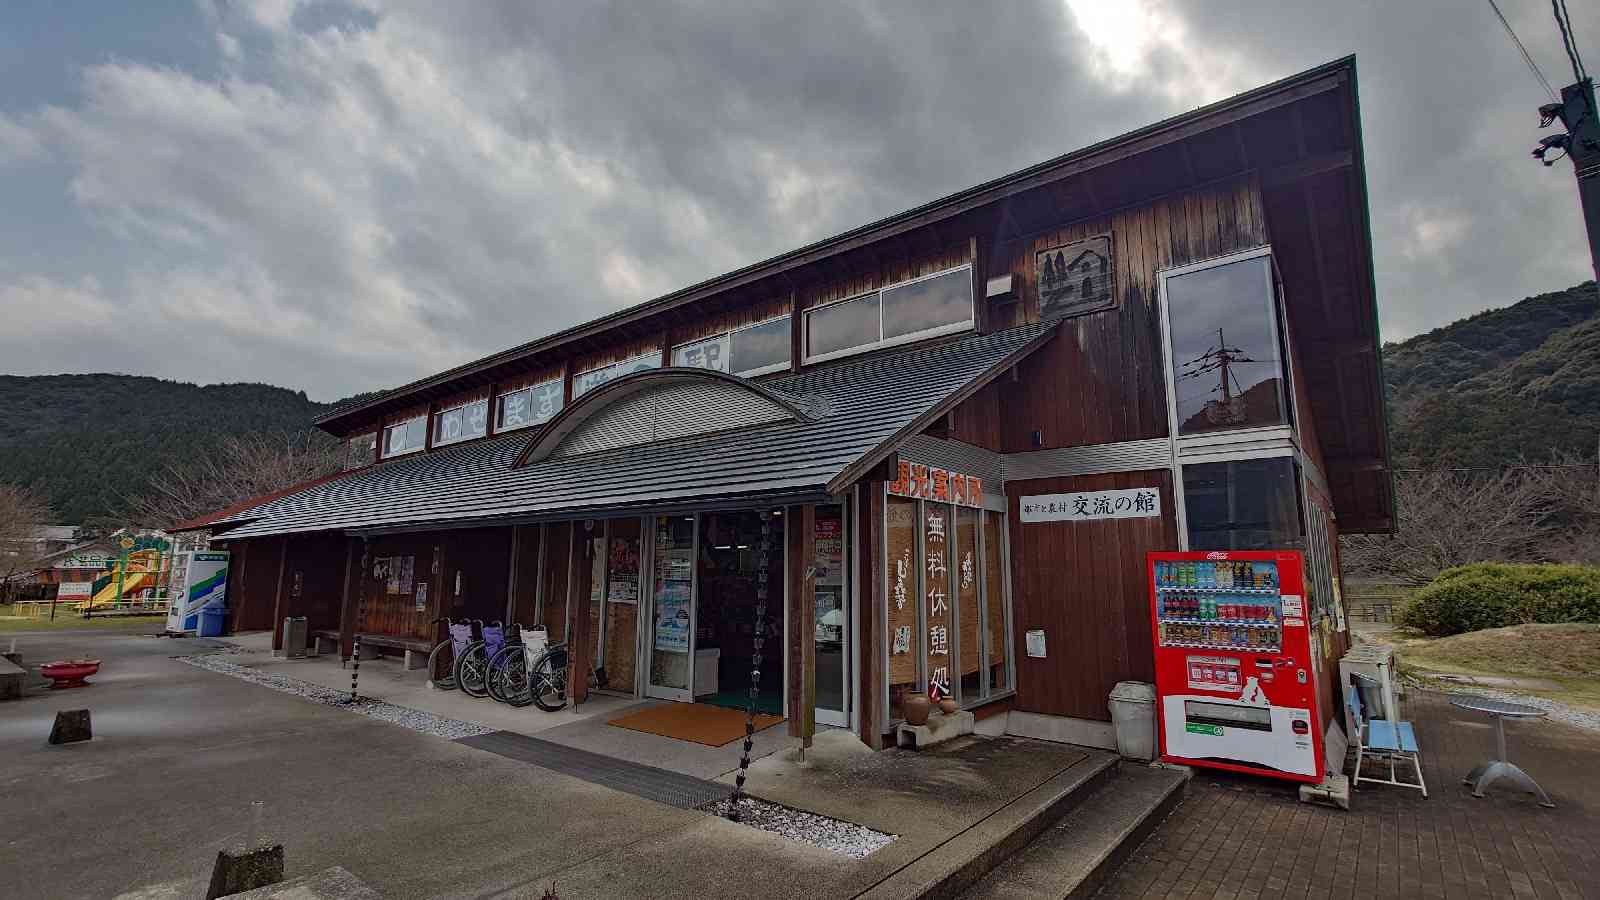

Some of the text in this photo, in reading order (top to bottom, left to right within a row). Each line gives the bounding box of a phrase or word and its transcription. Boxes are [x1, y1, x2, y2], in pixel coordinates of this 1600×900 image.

[1072, 491, 1156, 516] 交流の館
[927, 513, 950, 699] 無料休憩処
